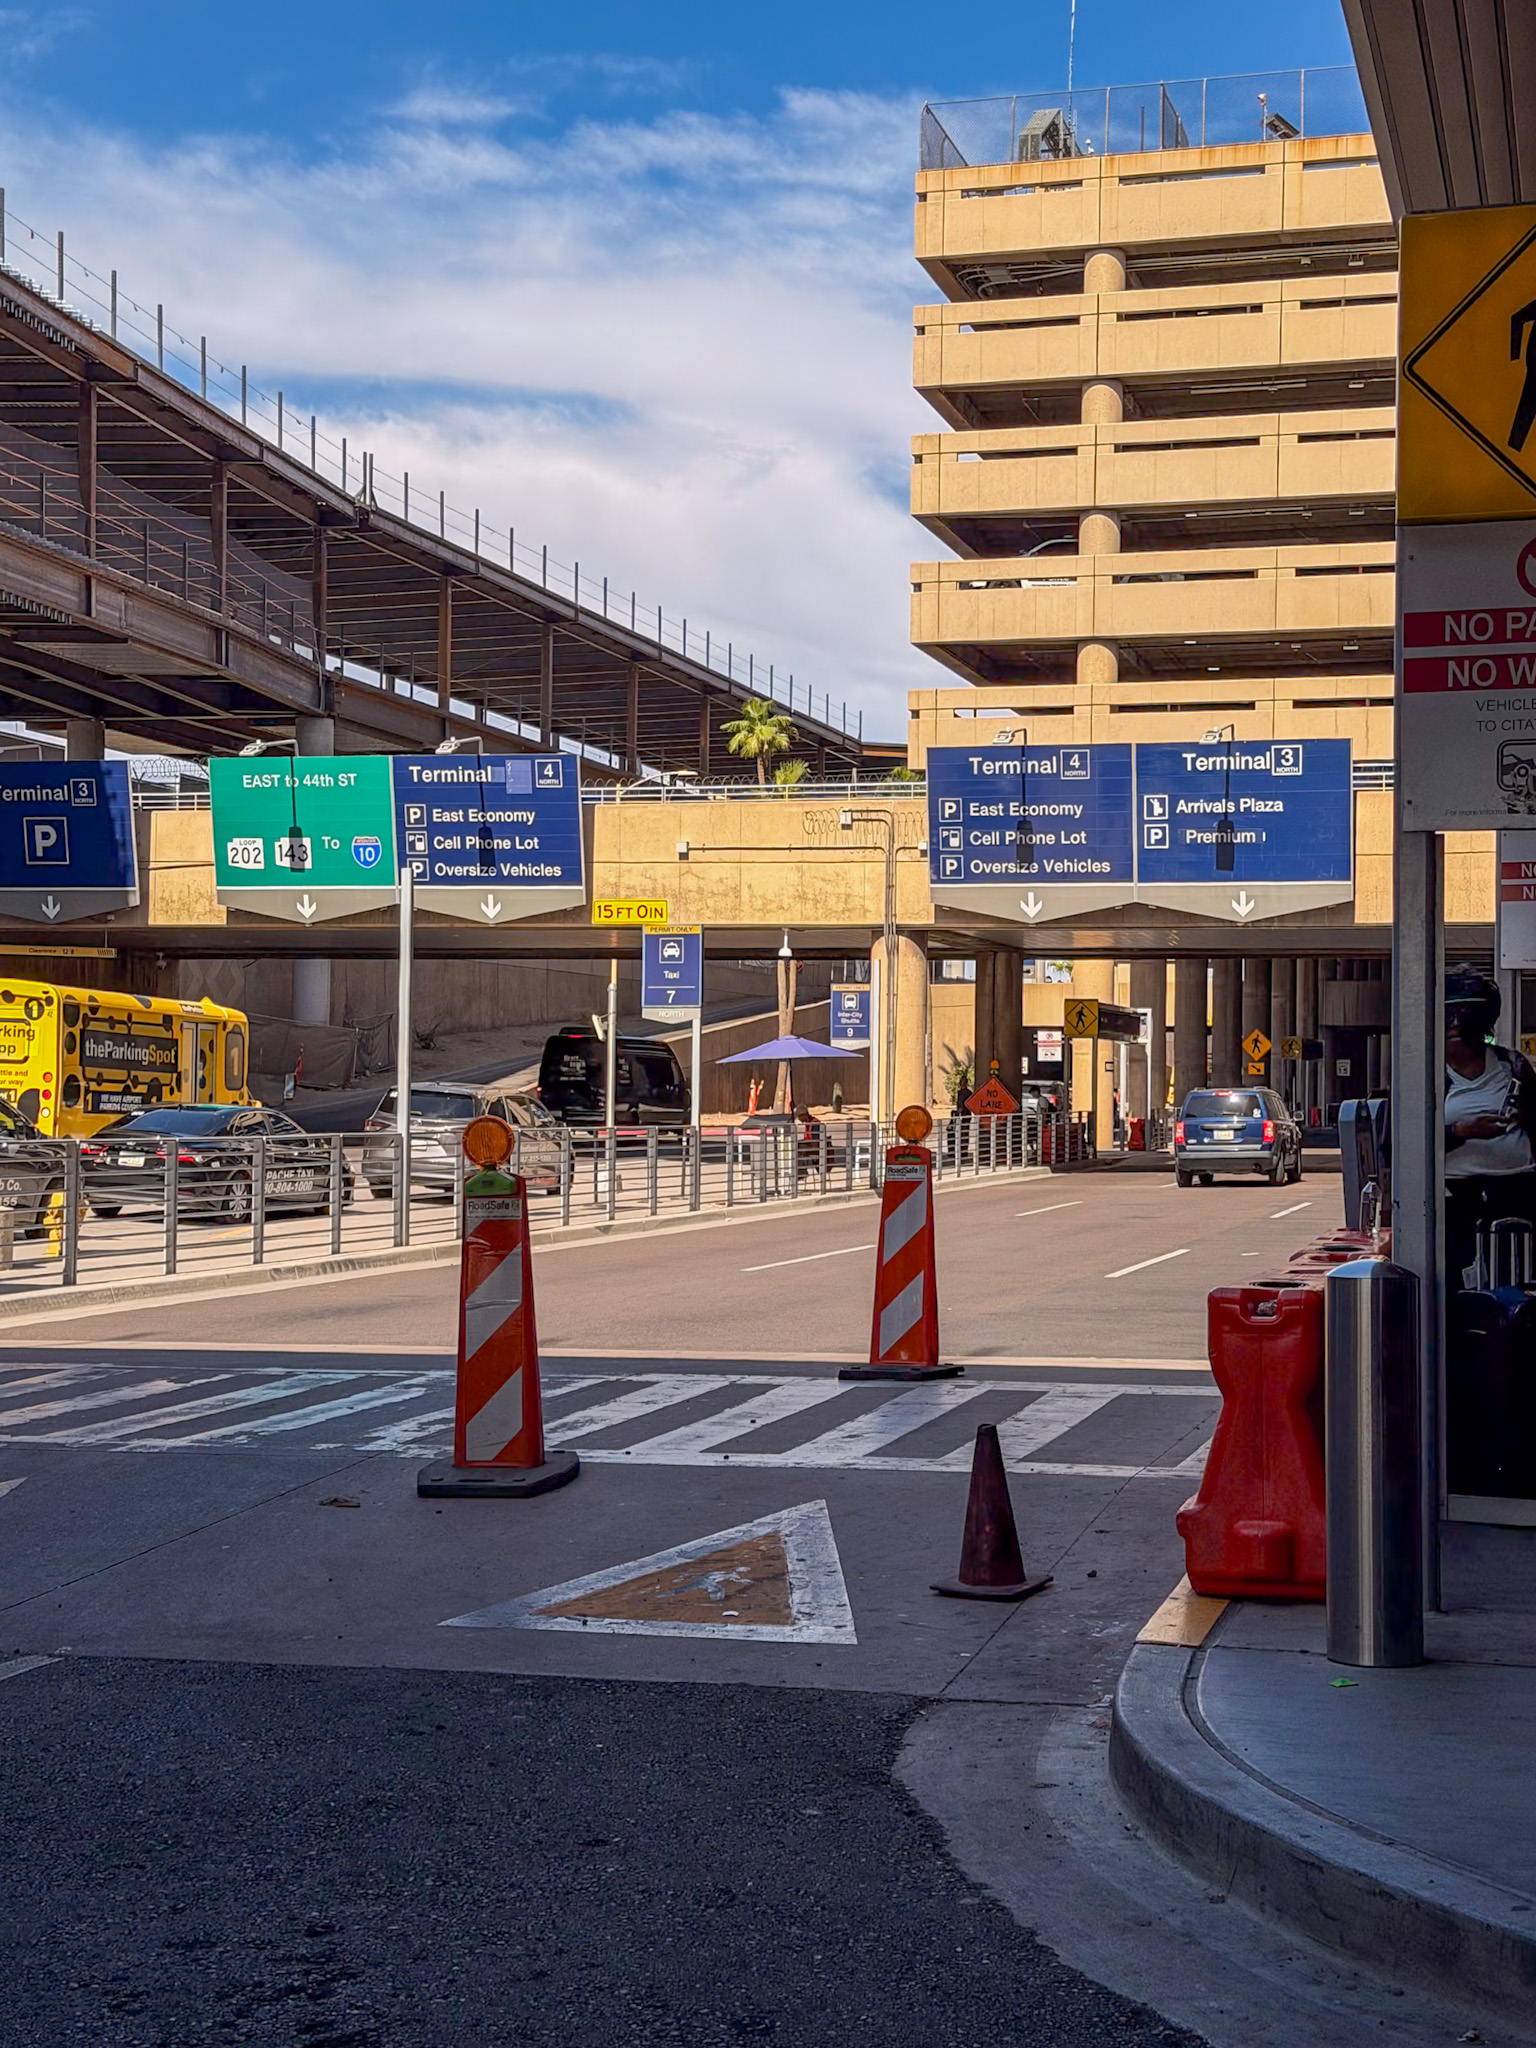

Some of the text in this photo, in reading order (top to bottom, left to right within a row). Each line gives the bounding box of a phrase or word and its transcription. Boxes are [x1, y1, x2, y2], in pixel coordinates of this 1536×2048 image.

[1444, 612, 1494, 642] NO
[1447, 658, 1497, 688] NO
[1476, 720, 1497, 732] TO
[968, 753, 1080, 775] Terminal 4
[1181, 748, 1294, 772] Terminal 3
[242, 773, 357, 788] EAST to 44th ST
[408, 763, 554, 783] Terminal 4
[78, 782, 89, 797] 3
[944, 801, 1083, 819] P East Economy
[1175, 798, 1284, 814] Arrivals Plaza
[409, 807, 536, 825] P East Economy
[35, 825, 57, 857] P
[433, 836, 461, 850] Cell
[465, 836, 512, 850] Phone
[515, 836, 539, 850] Lot
[969, 831, 1000, 846] Cell
[1005, 831, 1056, 845] Phone
[1060, 830, 1087, 845] Lot
[1150, 829, 1163, 844] P
[1186, 829, 1256, 844] Premium
[230, 836, 375, 864] 202 143 To 10
[412, 862, 562, 878] P Oversize Vehicles
[945, 858, 1111, 875] P Oversize Vehicles
[597, 904, 613, 919] 15
[616, 906, 632, 919] FT
[663, 970, 680, 979] Taxi
[666, 990, 676, 1004] 7
[28, 1000, 38, 1018] 1
[658, 1010, 685, 1018] NORTH
[846, 1027, 854, 1037] 9
[230, 1046, 239, 1076] 1
[986, 1089, 999, 1098] NO
[980, 1100, 1003, 1109] LANE
[888, 1166, 918, 1174] RoadSafe
[468, 1200, 510, 1210] RoadSafe
